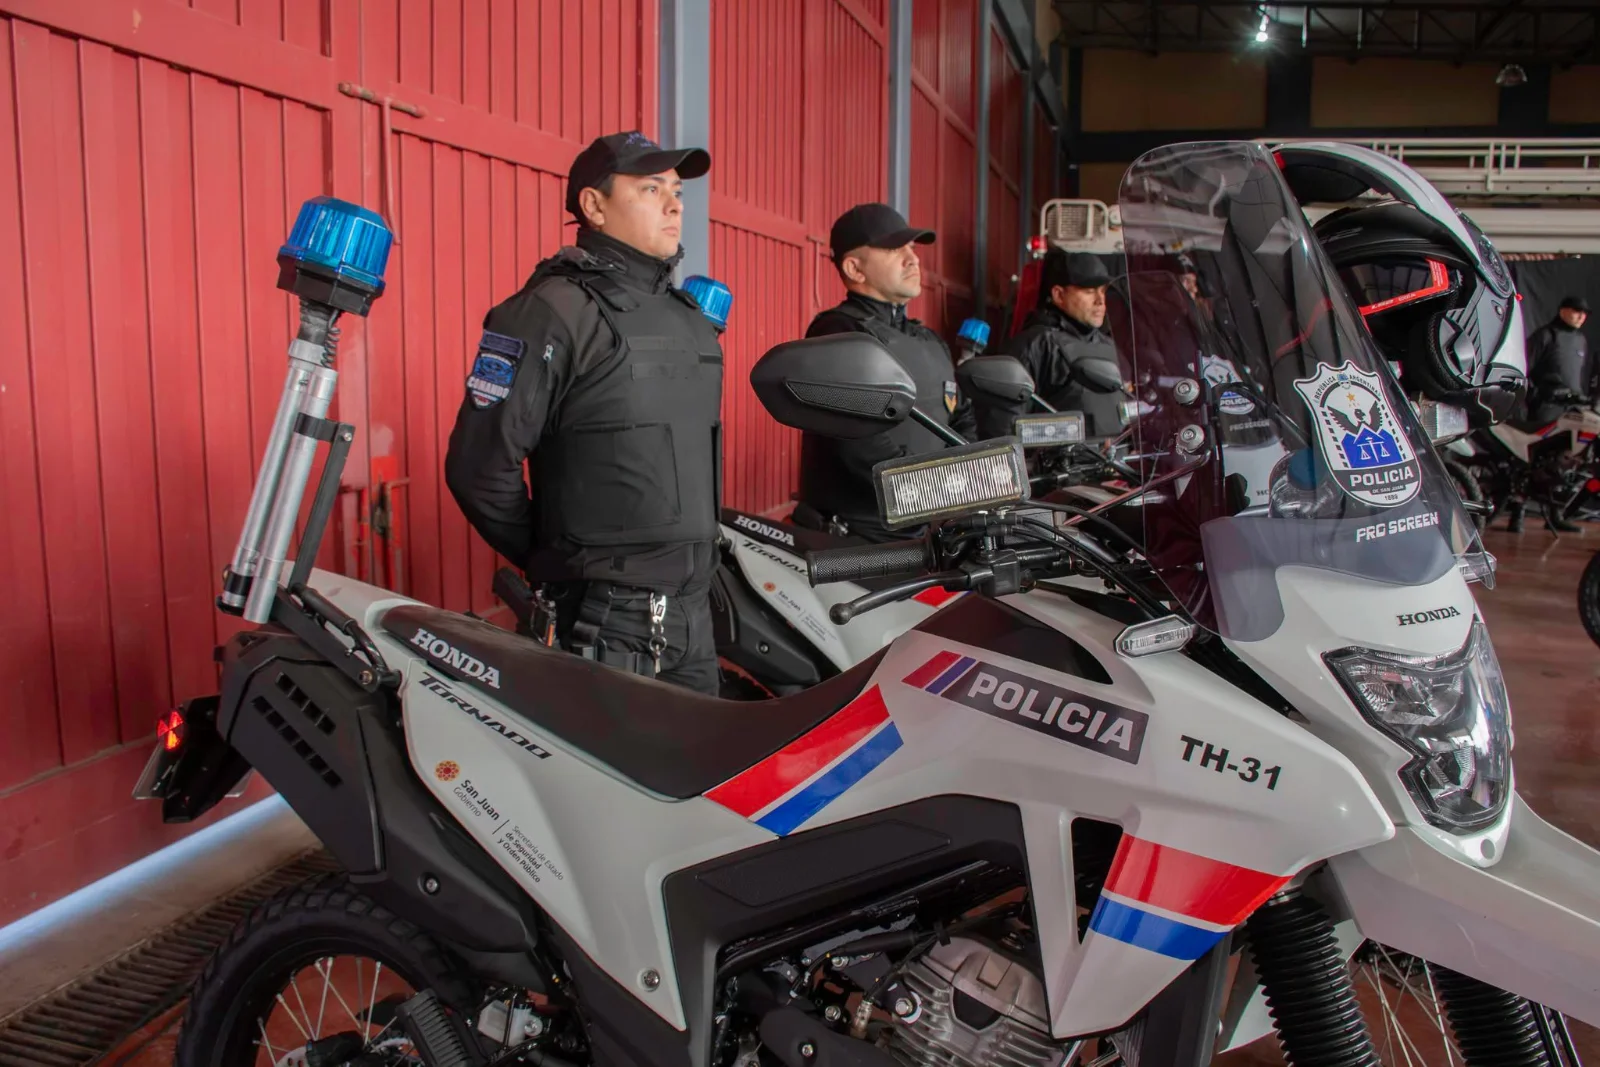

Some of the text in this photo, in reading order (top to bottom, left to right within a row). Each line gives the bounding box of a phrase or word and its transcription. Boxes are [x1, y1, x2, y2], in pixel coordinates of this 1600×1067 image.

[1349, 374, 1379, 394] ARGENTINA
[1350, 466, 1414, 487] POLICIA
[734, 514, 795, 547] HONDA
[1356, 511, 1439, 543] PRO SCREEN
[742, 538, 808, 577] TORNA
[1396, 605, 1461, 627] HONDA
[410, 628, 501, 689] HONDA
[967, 671, 1135, 751] POLICIA
[1179, 734, 1282, 791] TH-31
[453, 786, 482, 817] Gobierno
[461, 779, 500, 821] San Juan
[497, 837, 541, 883] y Orden Público
[505, 832, 542, 870] de Seguridad
[512, 825, 564, 881] Secretaría de Estado
